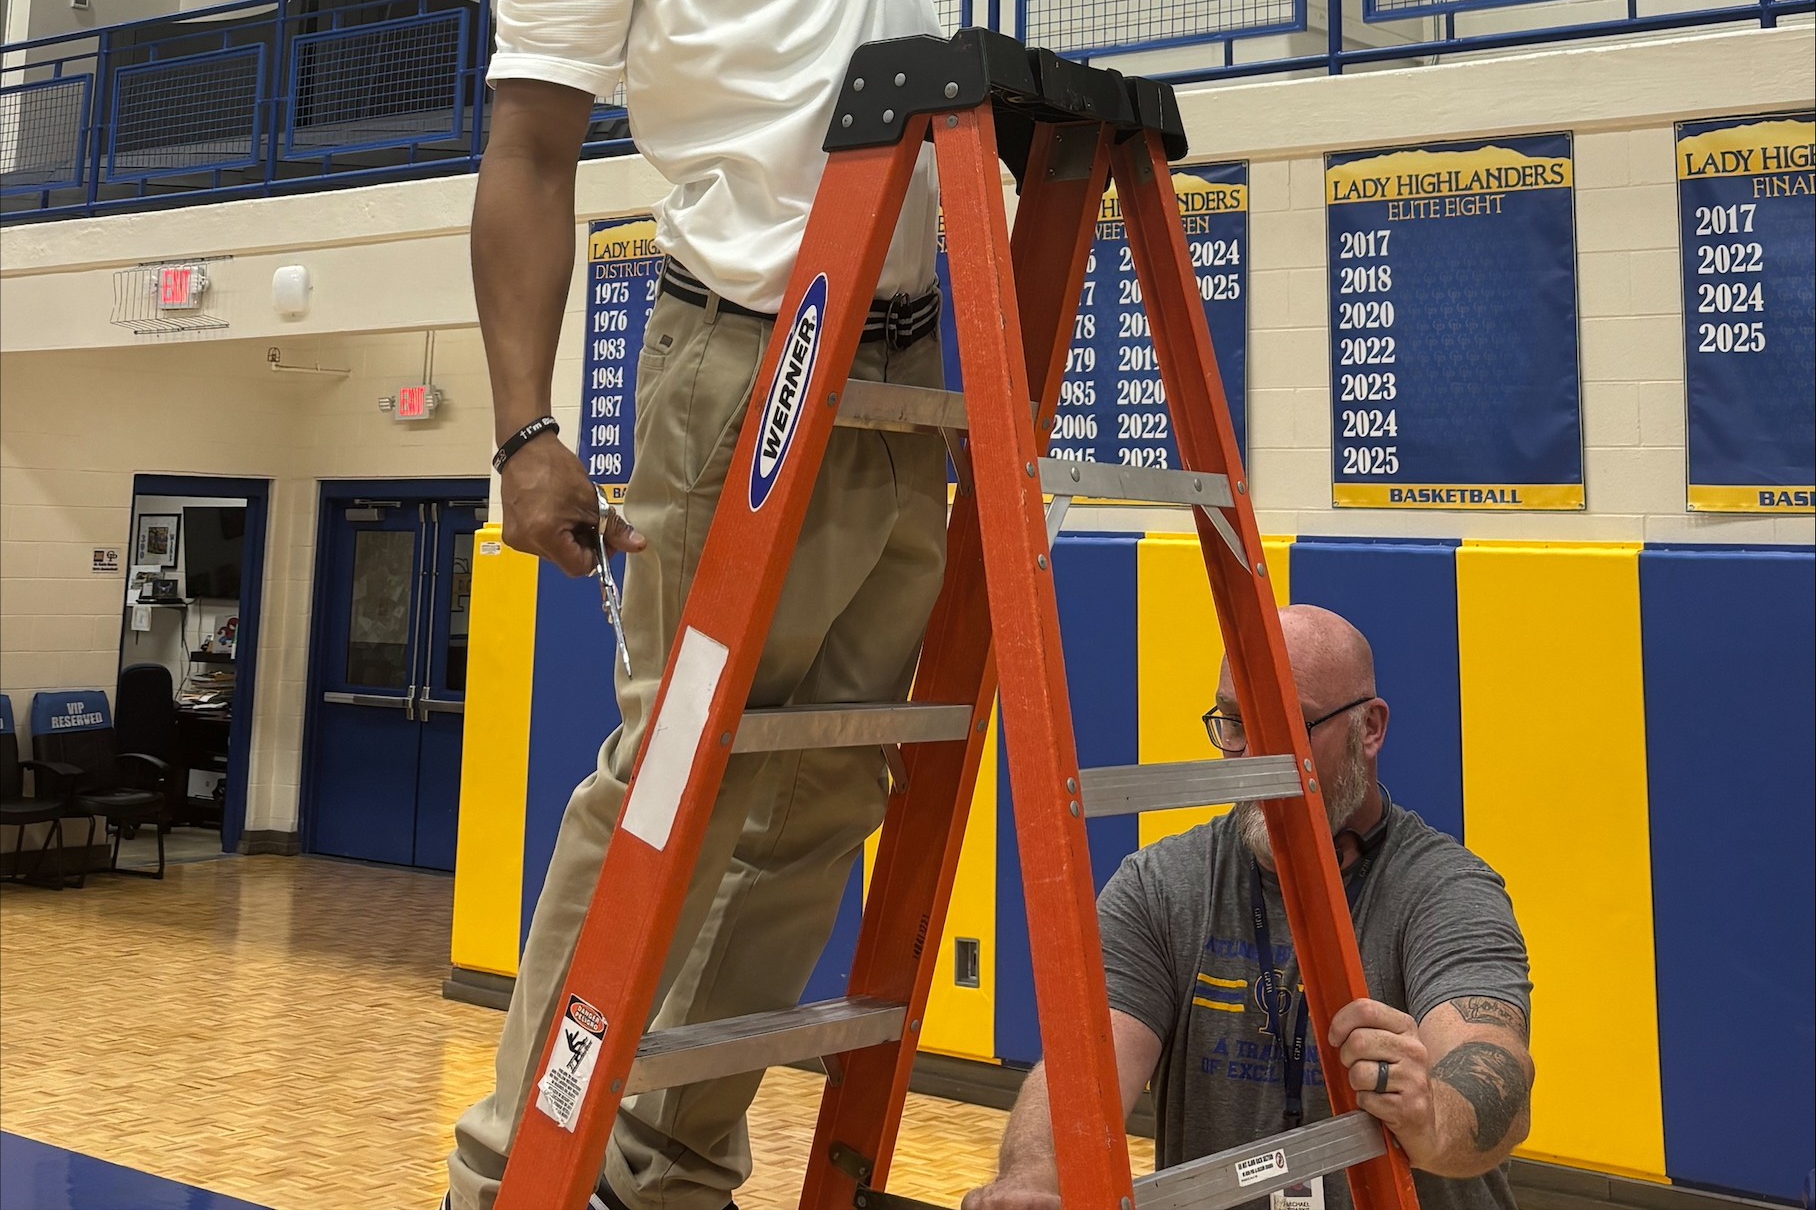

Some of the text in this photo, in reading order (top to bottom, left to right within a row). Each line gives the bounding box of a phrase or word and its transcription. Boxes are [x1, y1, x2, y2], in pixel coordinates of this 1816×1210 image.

[1685, 149, 1754, 176] LADY
[1333, 163, 1565, 202] LADY HIGHLANDERS
[1387, 194, 1506, 222] ELITE EIGHT
[1695, 203, 1756, 236] 2017
[593, 241, 630, 260] LADY
[1189, 239, 1240, 268] 2024
[1340, 229, 1391, 260] 2017
[596, 260, 653, 280] DISTRICT
[1698, 242, 1763, 275] 2022
[162, 269, 190, 303] EXIT
[1340, 265, 1392, 294] 2018
[595, 281, 629, 305] 1975
[1698, 282, 1764, 314] 2024
[593, 310, 628, 333] 1976
[1118, 312, 1151, 338] 201
[1339, 300, 1395, 330] 2020
[593, 338, 626, 361] 1983
[1699, 322, 1766, 353] 2025
[1340, 336, 1396, 366] 2022
[592, 366, 623, 389] 1984
[763, 317, 815, 460] WERNER
[1340, 372, 1397, 402] 2023
[399, 386, 426, 416] EXIT
[1057, 380, 1096, 406] 985
[1117, 379, 1166, 405] 2020
[591, 395, 622, 418] 1987
[591, 424, 620, 447] 1991
[1050, 414, 1098, 439] 2006
[1117, 413, 1168, 439] 2022
[1342, 409, 1398, 438] 2024
[588, 453, 622, 476] 1998
[1118, 447, 1168, 470] 2023
[1343, 446, 1399, 475] 2025
[1389, 488, 1523, 504] BASKETBALL
[51, 712, 103, 729] RESERVED
[66, 702, 85, 714] VIP
[577, 1005, 600, 1025] DANGER
